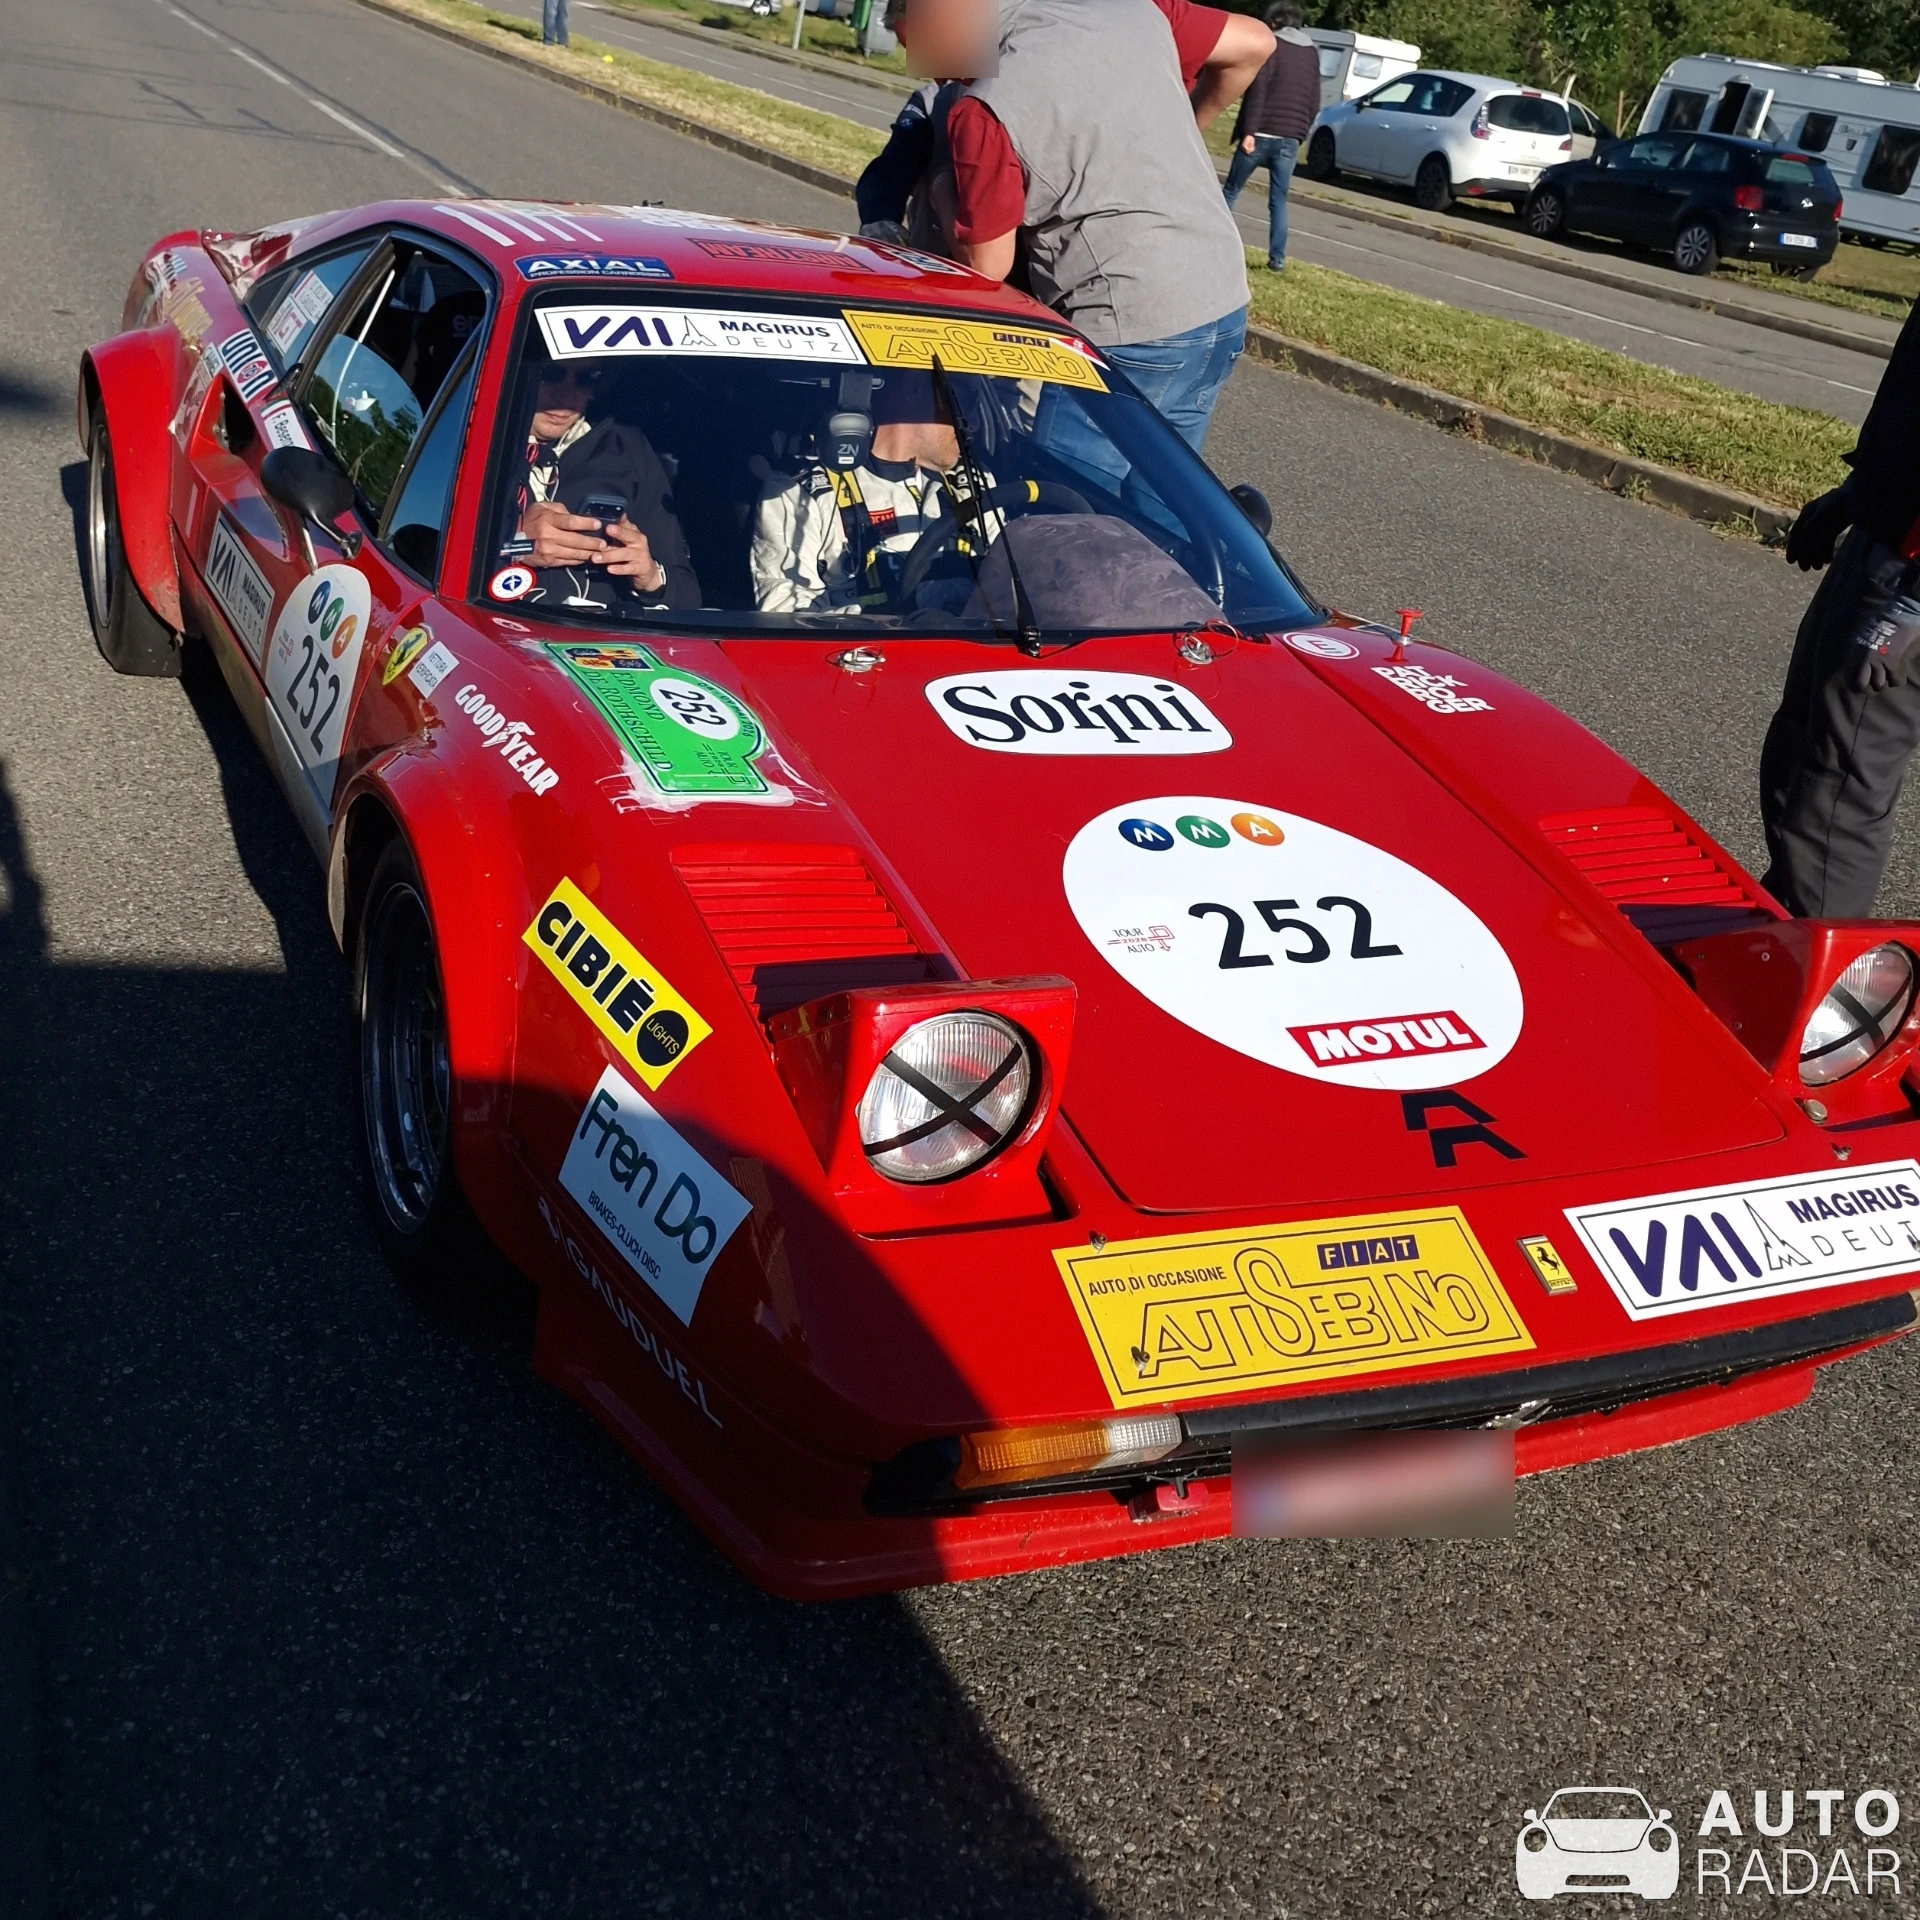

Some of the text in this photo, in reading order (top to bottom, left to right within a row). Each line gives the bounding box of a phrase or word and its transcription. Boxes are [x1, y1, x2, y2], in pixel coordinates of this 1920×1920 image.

[528, 260, 665, 273] AXIAL
[563, 316, 673, 349] VAI
[718, 320, 830, 337] MAGIRUS
[726, 335, 843, 352] DEUTZ
[861, 322, 882, 330] AUTO
[894, 325, 940, 335] OCCASIONE
[995, 332, 1049, 347] FIAT
[837, 444, 859, 456] ZN
[211, 533, 236, 597] VAI
[242, 573, 266, 620] MAGIRUS
[415, 662, 439, 688] VERIFICATA
[428, 651, 449, 675] VETTURA
[1371, 665, 1432, 679] PAT
[287, 635, 340, 757] 252
[610, 671, 666, 721] EDMOND
[1389, 674, 1469, 690] RICK
[1405, 686, 1457, 702] RO
[581, 670, 674, 772] DE ROTHSCHILD
[658, 689, 728, 726] 252
[941, 681, 1213, 744] Sorini
[1426, 697, 1497, 714] GER
[1112, 928, 1144, 938] TOUR
[1127, 943, 1155, 953] AUTO
[1188, 896, 1404, 970] 252
[537, 901, 655, 1035] CIBIÉ
[646, 1018, 680, 1056] LIGHTS
[1306, 1017, 1473, 1061] MOTUL
[579, 1088, 717, 1265] Fren Do
[1786, 1183, 1920, 1224] MAGIRUS
[588, 1190, 662, 1281] BRAKES-CLUCH DISC
[1321, 1237, 1417, 1268] FIAT
[1608, 1212, 1763, 1297] VAI
[1088, 1265, 1228, 1297] AUTO DI OCCASIONE
